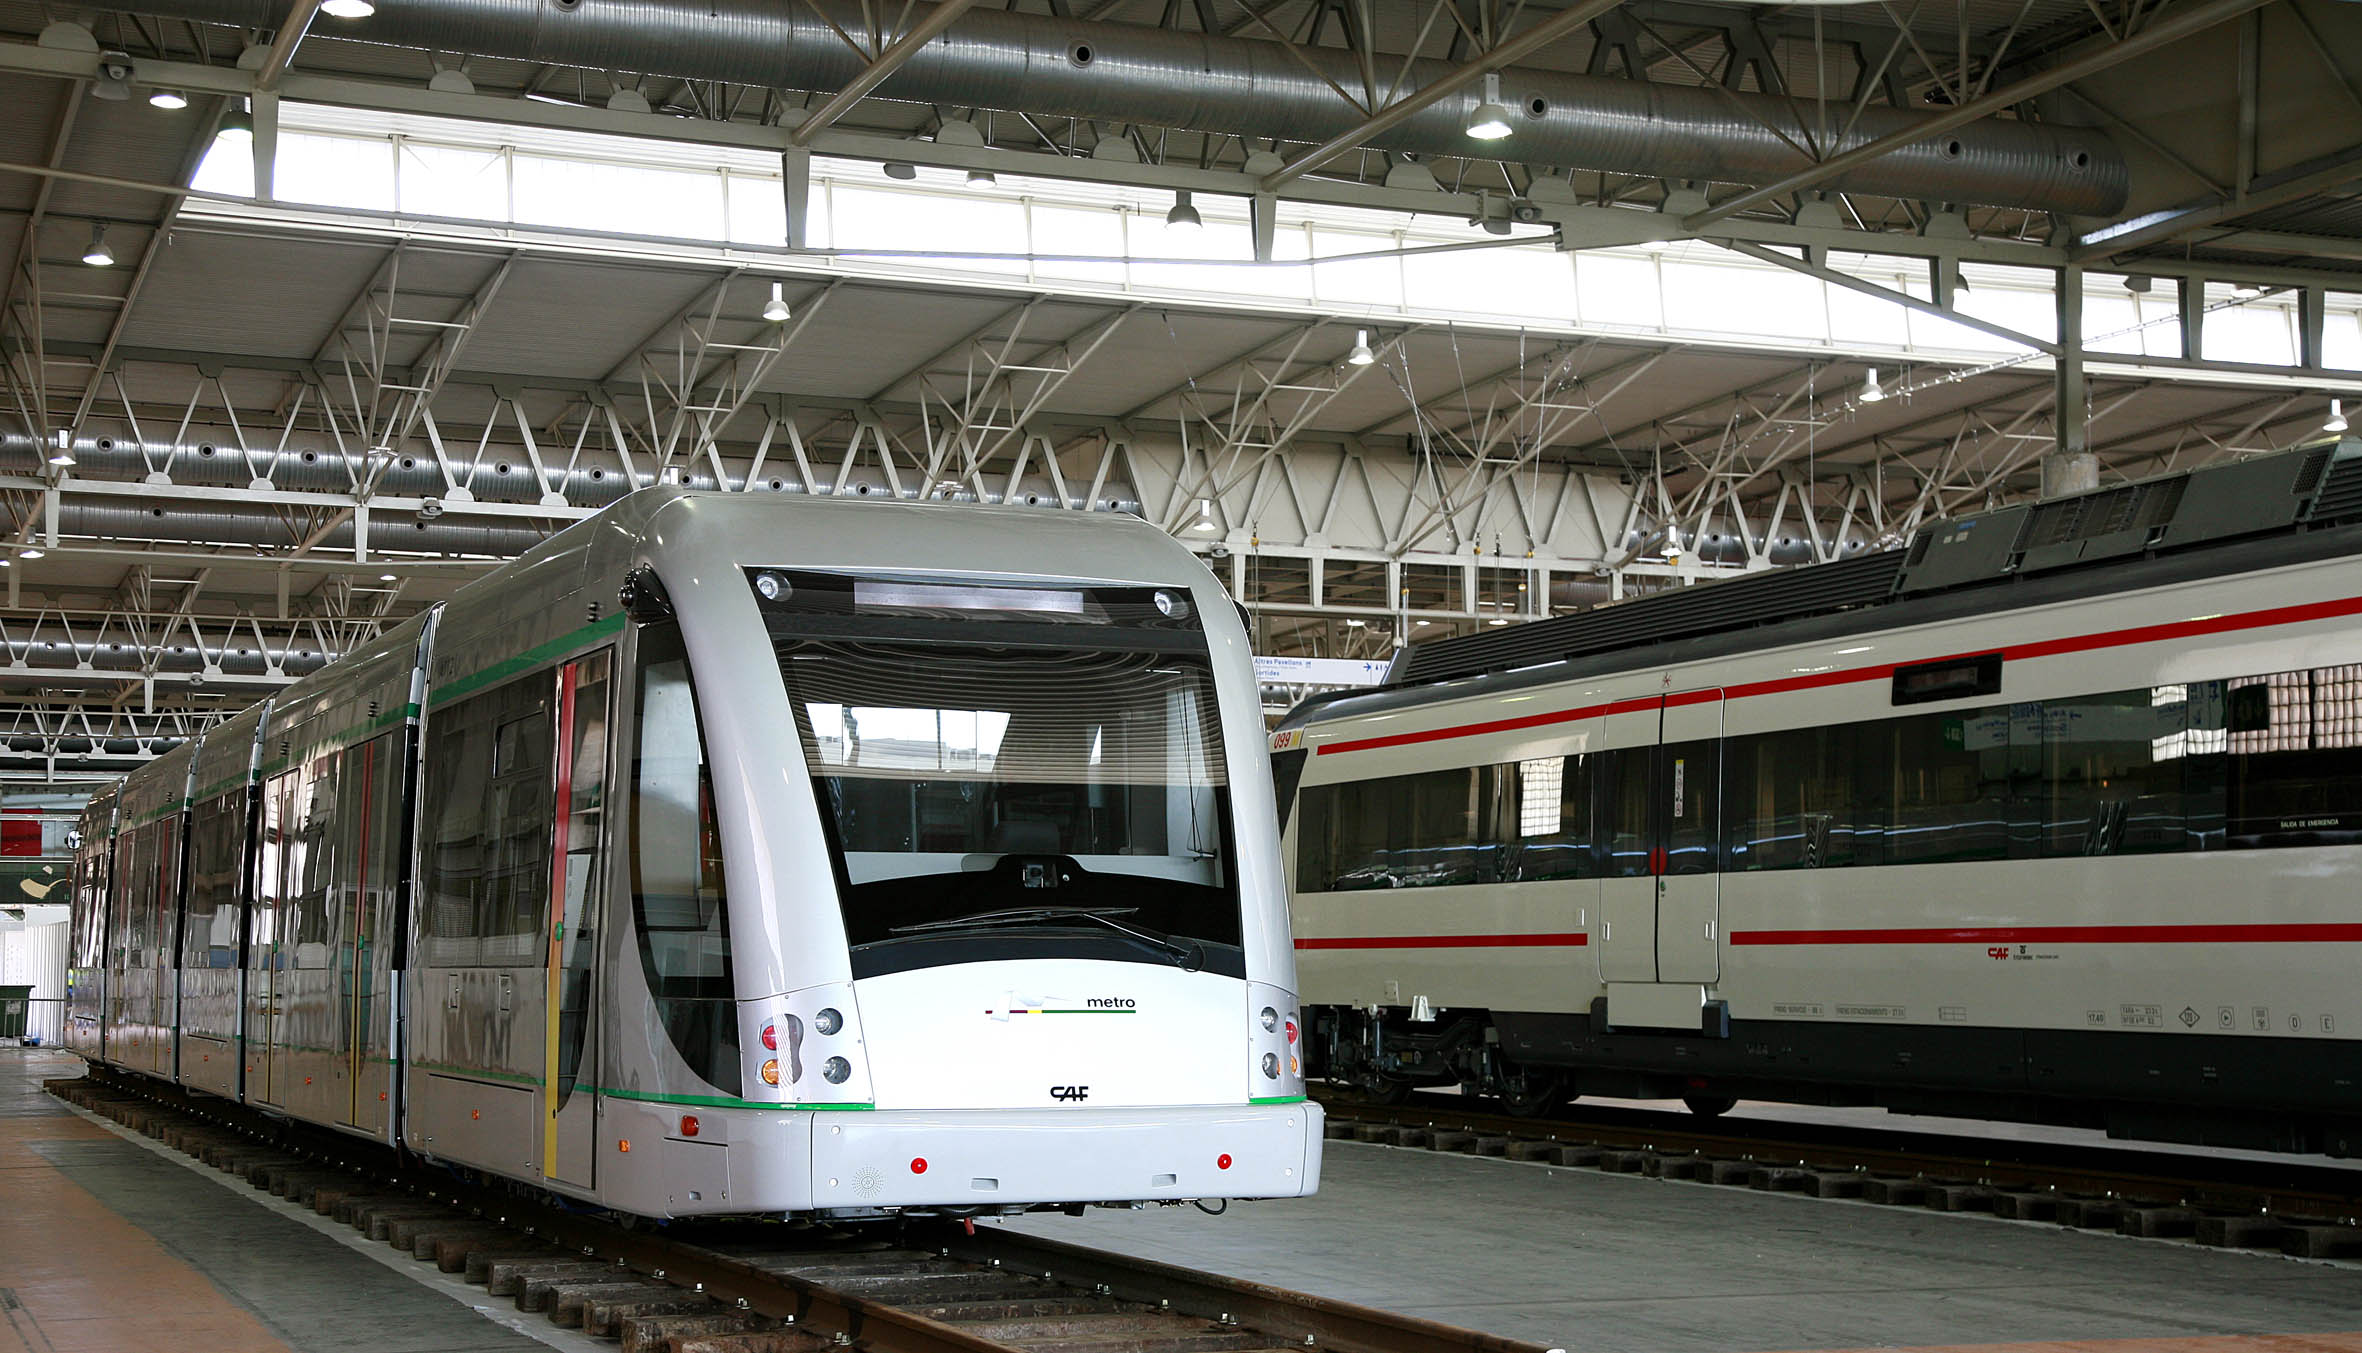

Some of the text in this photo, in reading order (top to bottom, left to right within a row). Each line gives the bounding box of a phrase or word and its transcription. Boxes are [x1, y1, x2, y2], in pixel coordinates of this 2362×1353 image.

[1274, 732, 1291, 748] 099
[1988, 947, 2009, 960] CAF
[1087, 997, 1136, 1008] metro
[1050, 1086, 1089, 1102] CAF
